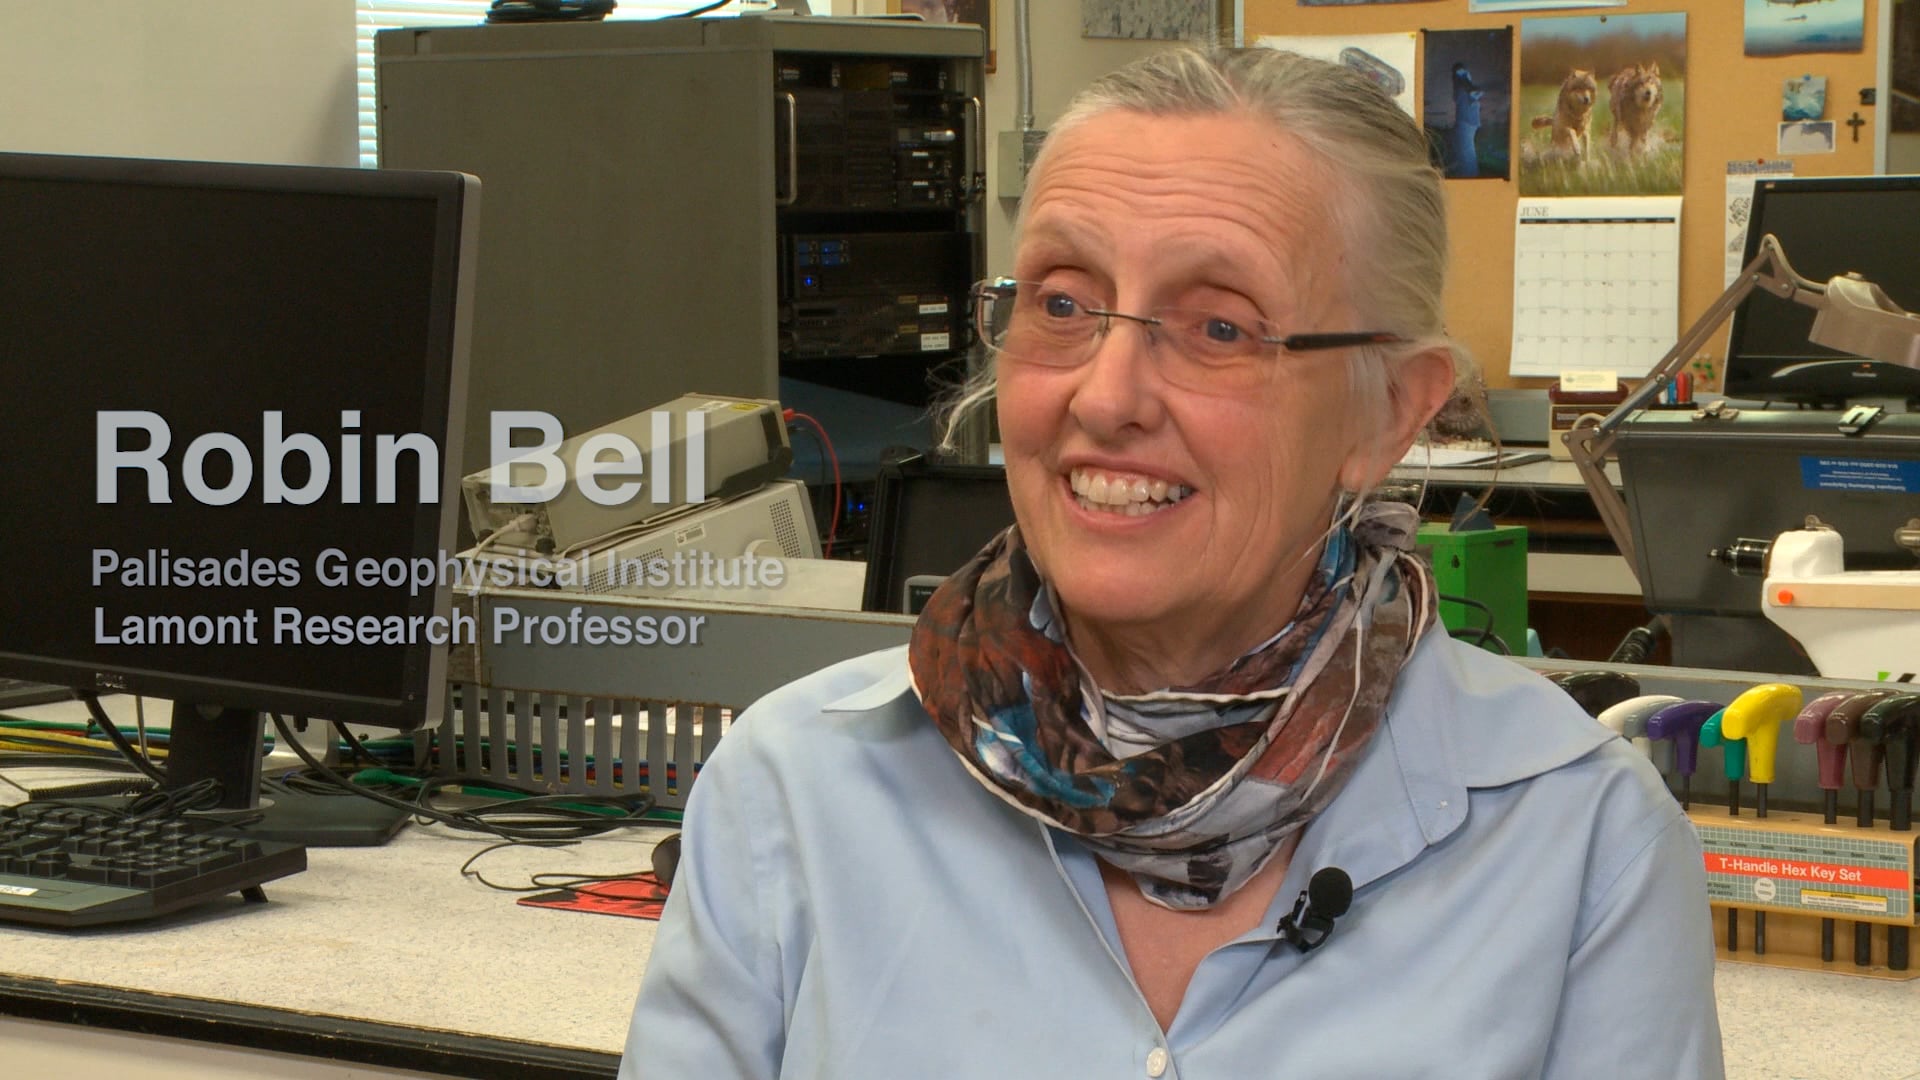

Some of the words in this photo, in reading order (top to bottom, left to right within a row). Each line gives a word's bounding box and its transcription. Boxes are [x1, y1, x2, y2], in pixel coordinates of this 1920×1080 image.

[1520, 206, 1550, 217] JUNE
[1719, 857, 1778, 875] T-Handle
[1781, 861, 1808, 876] Hex
[1810, 866, 1836, 882] Key
[1839, 868, 1862, 882] Set
